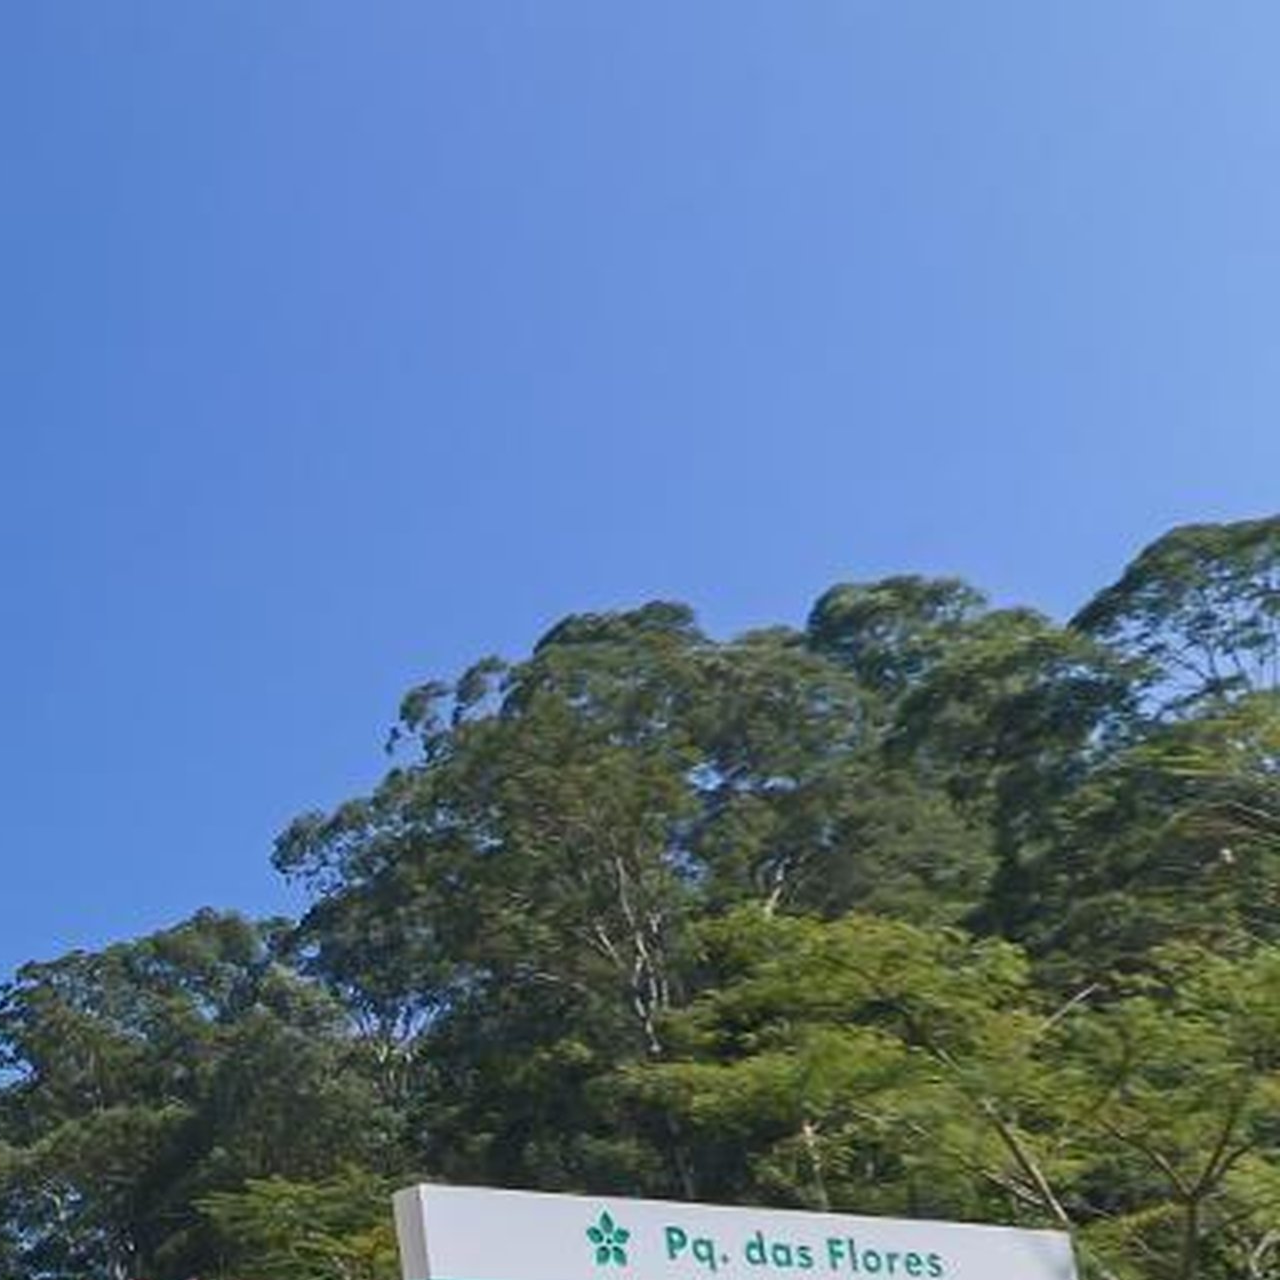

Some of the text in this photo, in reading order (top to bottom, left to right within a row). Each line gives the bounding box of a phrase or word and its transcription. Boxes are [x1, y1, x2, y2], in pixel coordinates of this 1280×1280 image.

[664, 1226, 943, 1277] Pq. das Flores
